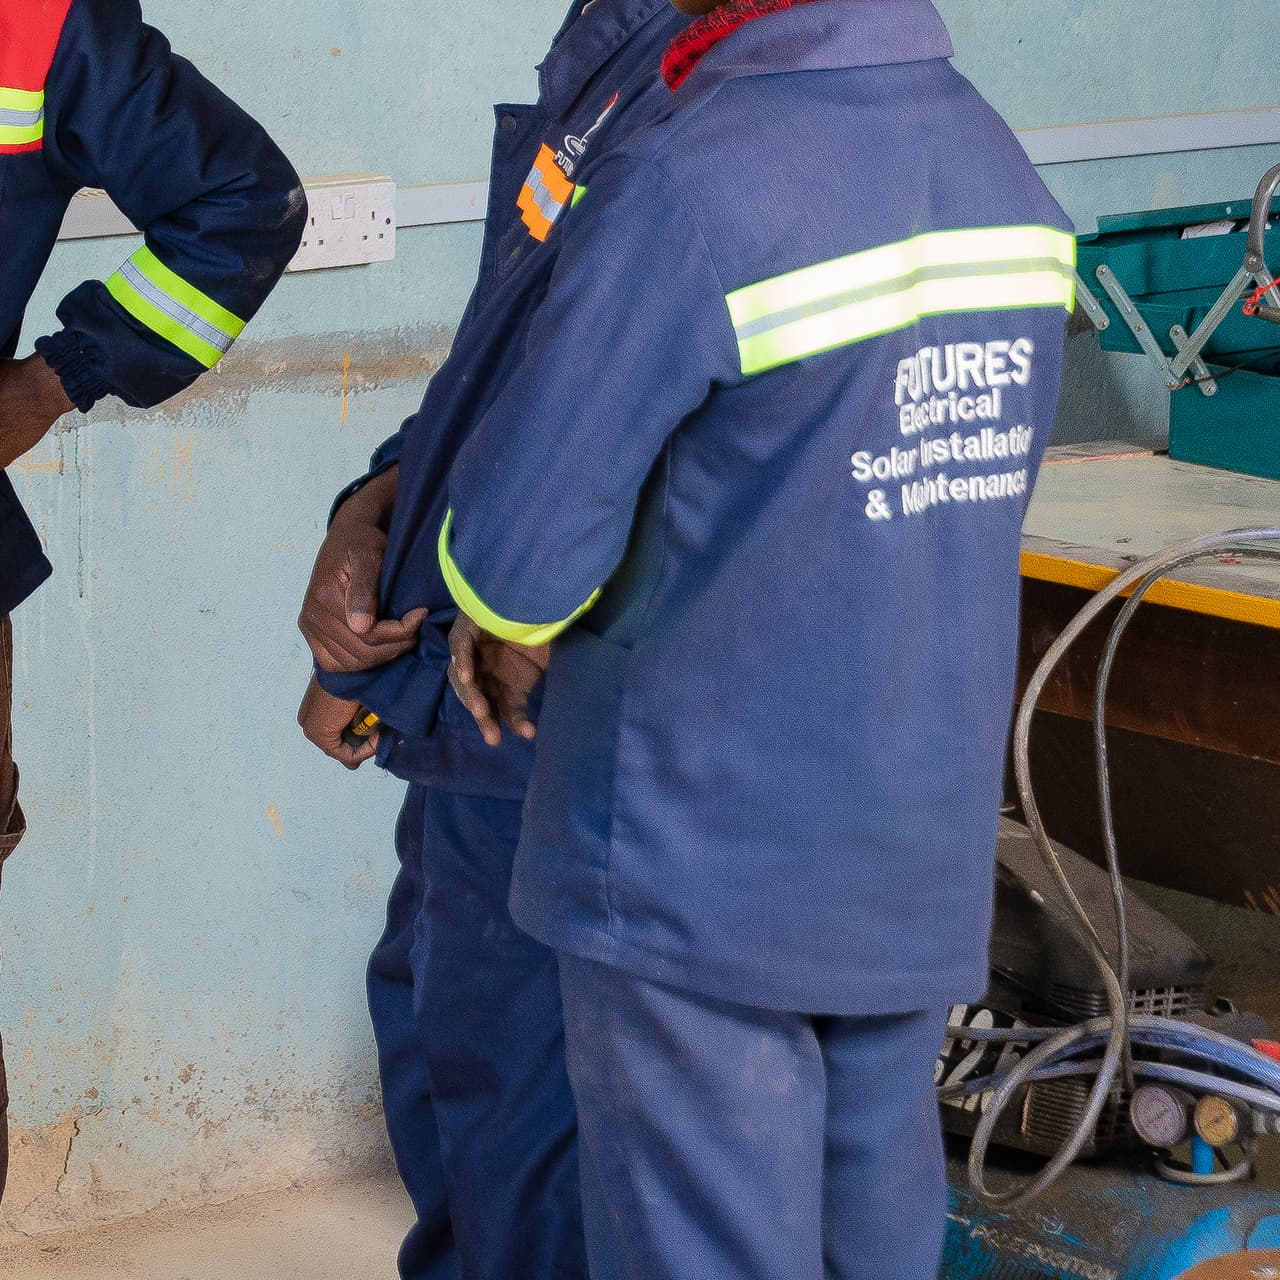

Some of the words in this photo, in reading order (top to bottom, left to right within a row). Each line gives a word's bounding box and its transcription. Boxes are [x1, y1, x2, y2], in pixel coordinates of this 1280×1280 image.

[893, 337, 1035, 406] FUTURES
[898, 387, 1003, 437] Electrical
[850, 446, 918, 483] Solar
[864, 488, 893, 522] &
